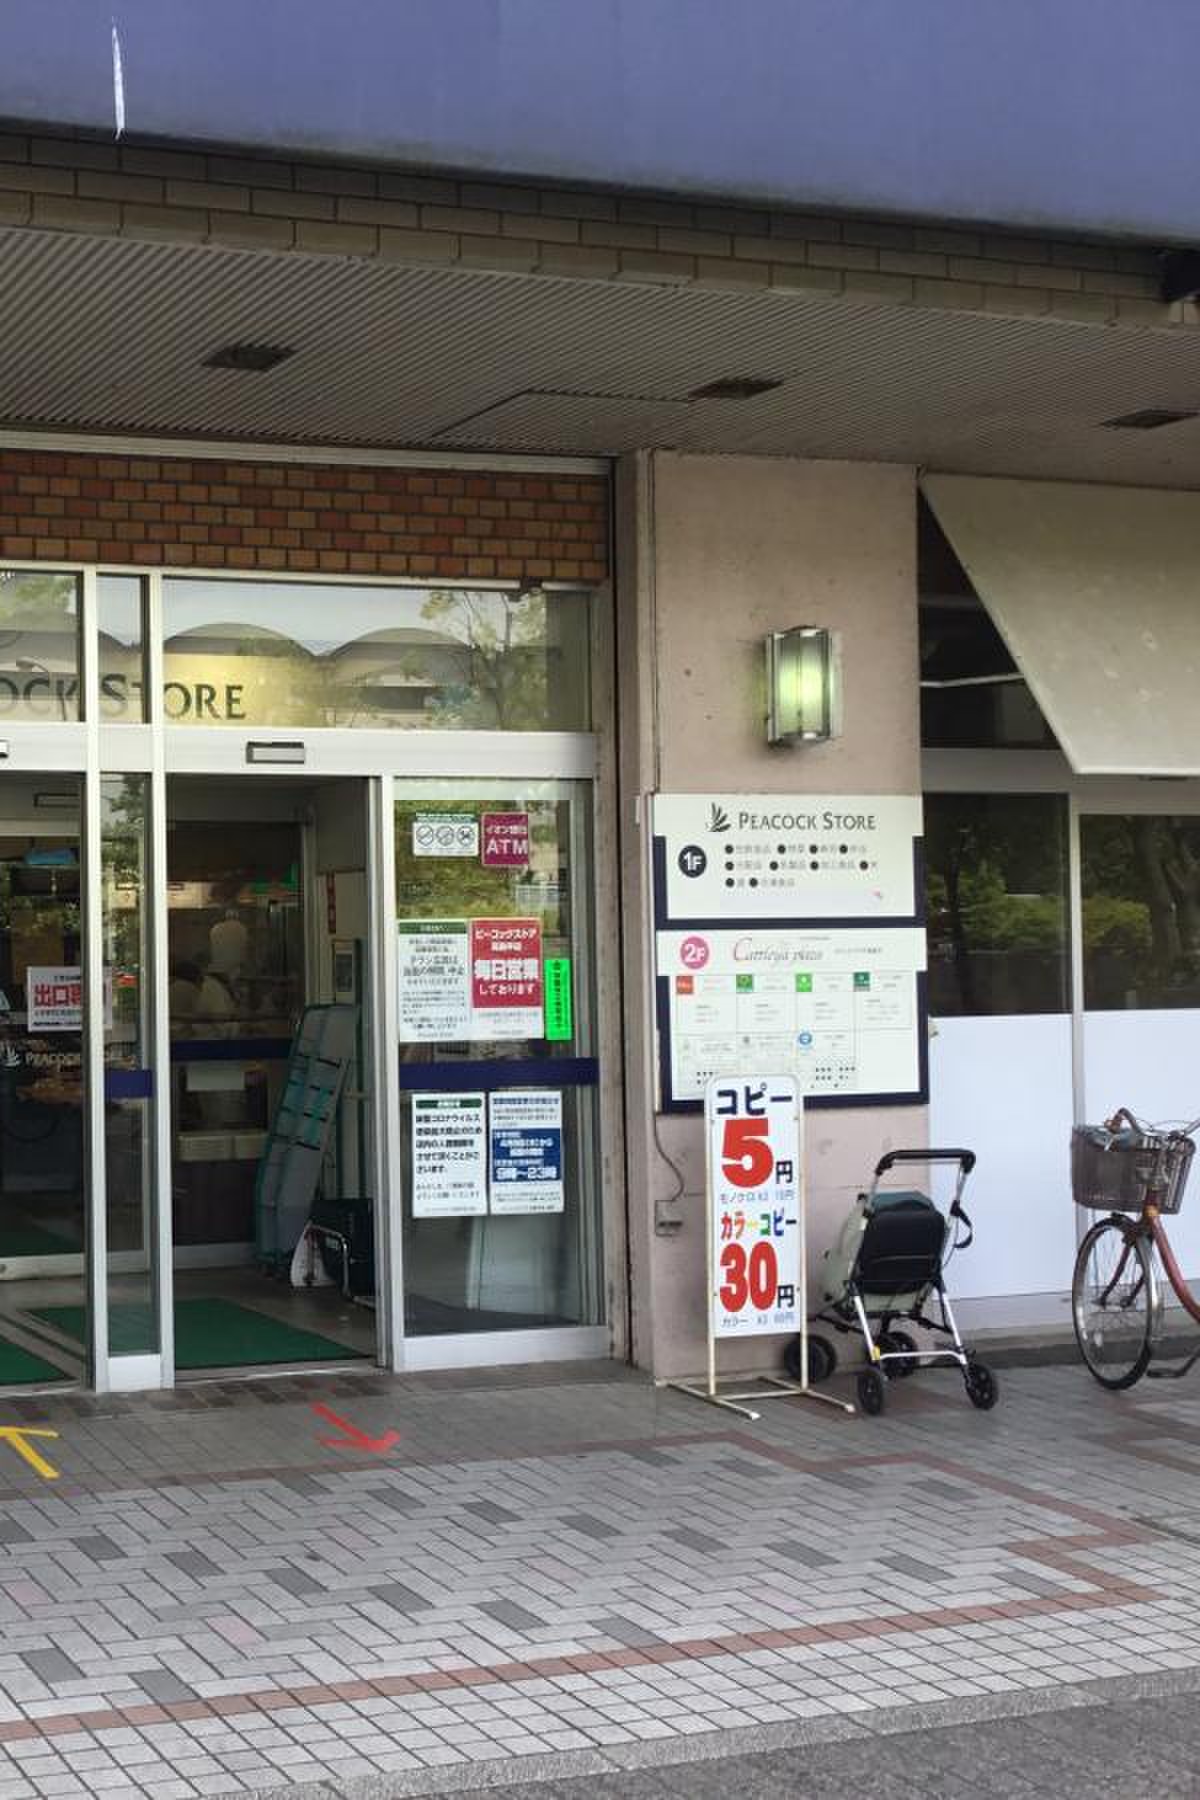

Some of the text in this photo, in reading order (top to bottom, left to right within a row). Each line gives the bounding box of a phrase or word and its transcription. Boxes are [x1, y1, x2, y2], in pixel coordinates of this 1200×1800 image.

[739, 812, 876, 830] PEACOCK STORE
[486, 839, 529, 855] ATM
[683, 854, 702, 872] 1F
[475, 928, 538, 941] ピーコックストア
[686, 943, 706, 961] 2F
[474, 958, 539, 980] 毎日営業
[479, 983, 536, 995] しております
[716, 1083, 793, 1116] コピー
[721, 1207, 797, 1240] カラーコピー
